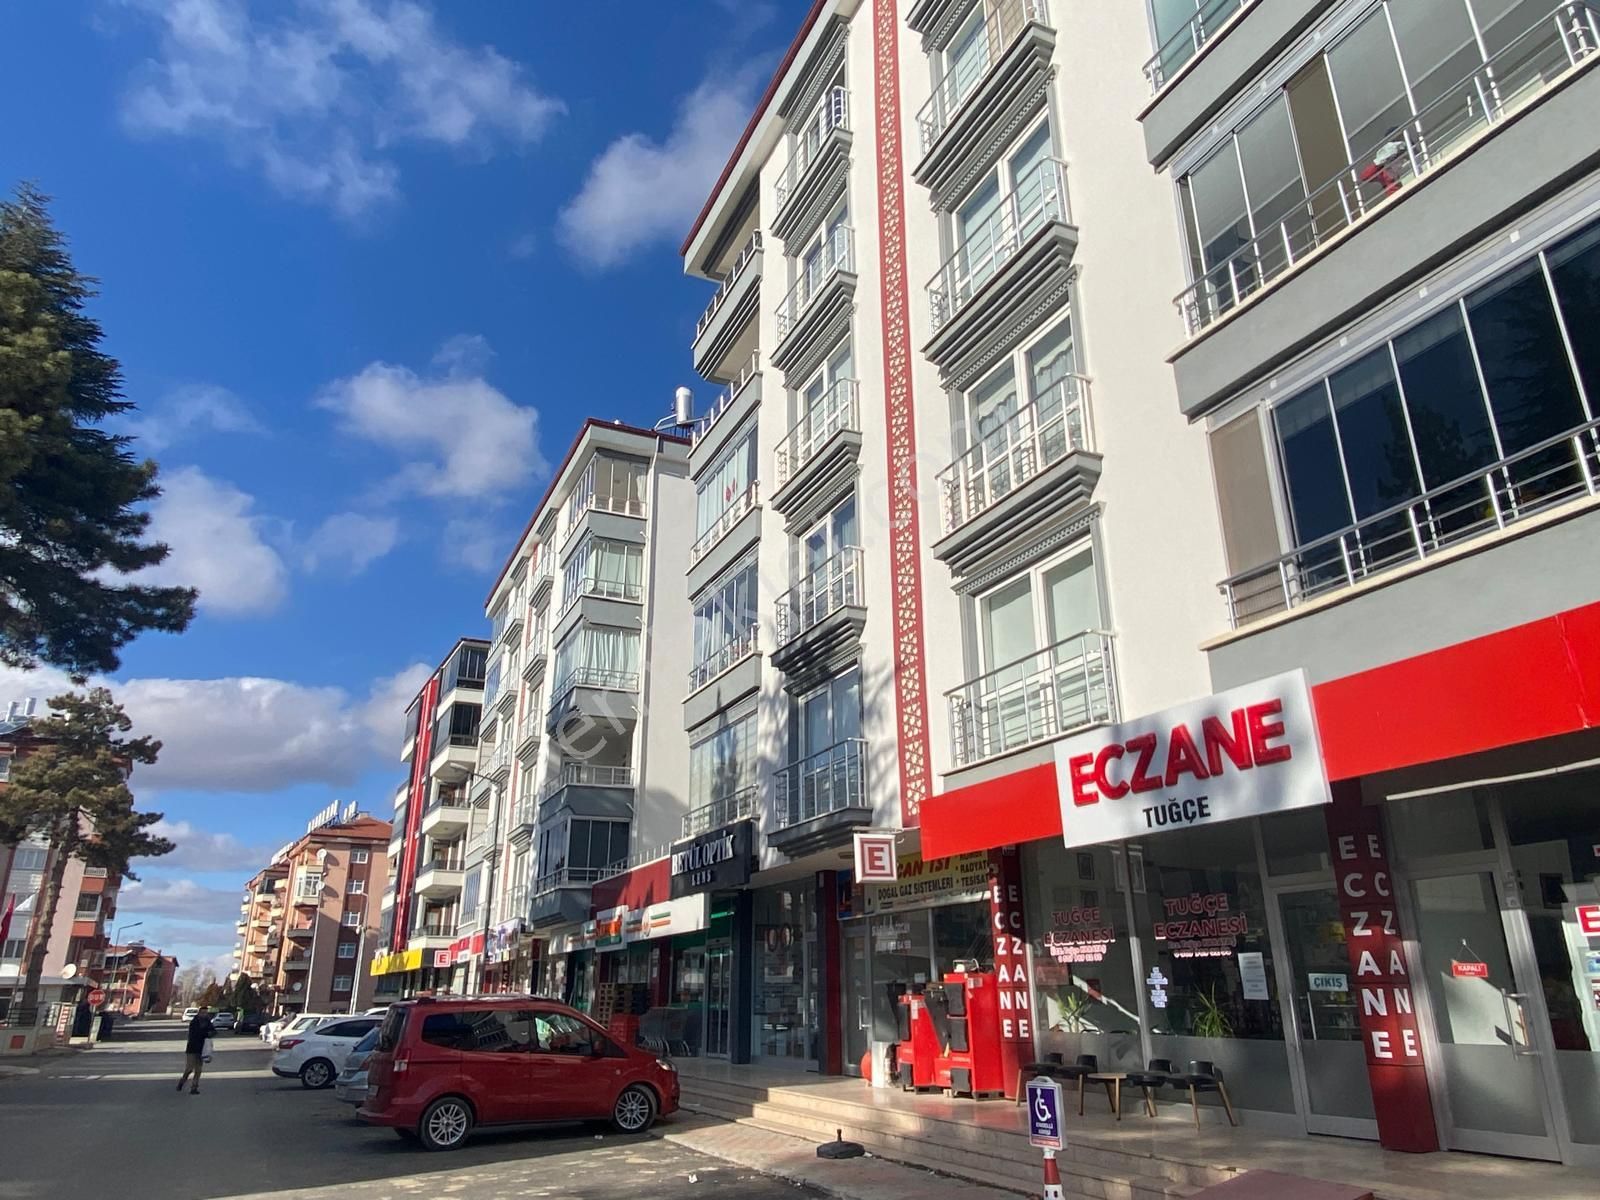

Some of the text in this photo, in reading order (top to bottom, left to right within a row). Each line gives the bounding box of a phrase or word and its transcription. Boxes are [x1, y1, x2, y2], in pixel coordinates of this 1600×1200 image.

[1069, 698, 1292, 807] ECZANE
[1142, 796, 1211, 828] TUĞÇE
[671, 830, 735, 876] BETÜL OPTİK
[867, 847, 886, 871] E
[878, 873, 954, 900] DOĞAL GAZ SİSTEMLERİ
[1052, 906, 1101, 926] TUĞÇE
[1164, 893, 1229, 916] TUĞÇE
[1153, 912, 1248, 940] ECZANESİ
[993, 885, 1013, 1038] ECZANE
[1008, 884, 1030, 1038] ECZANE
[1338, 835, 1393, 1059] ECZANE
[1367, 834, 1418, 1057] ECZANE
[1313, 974, 1344, 989] ÇIKIŞ
